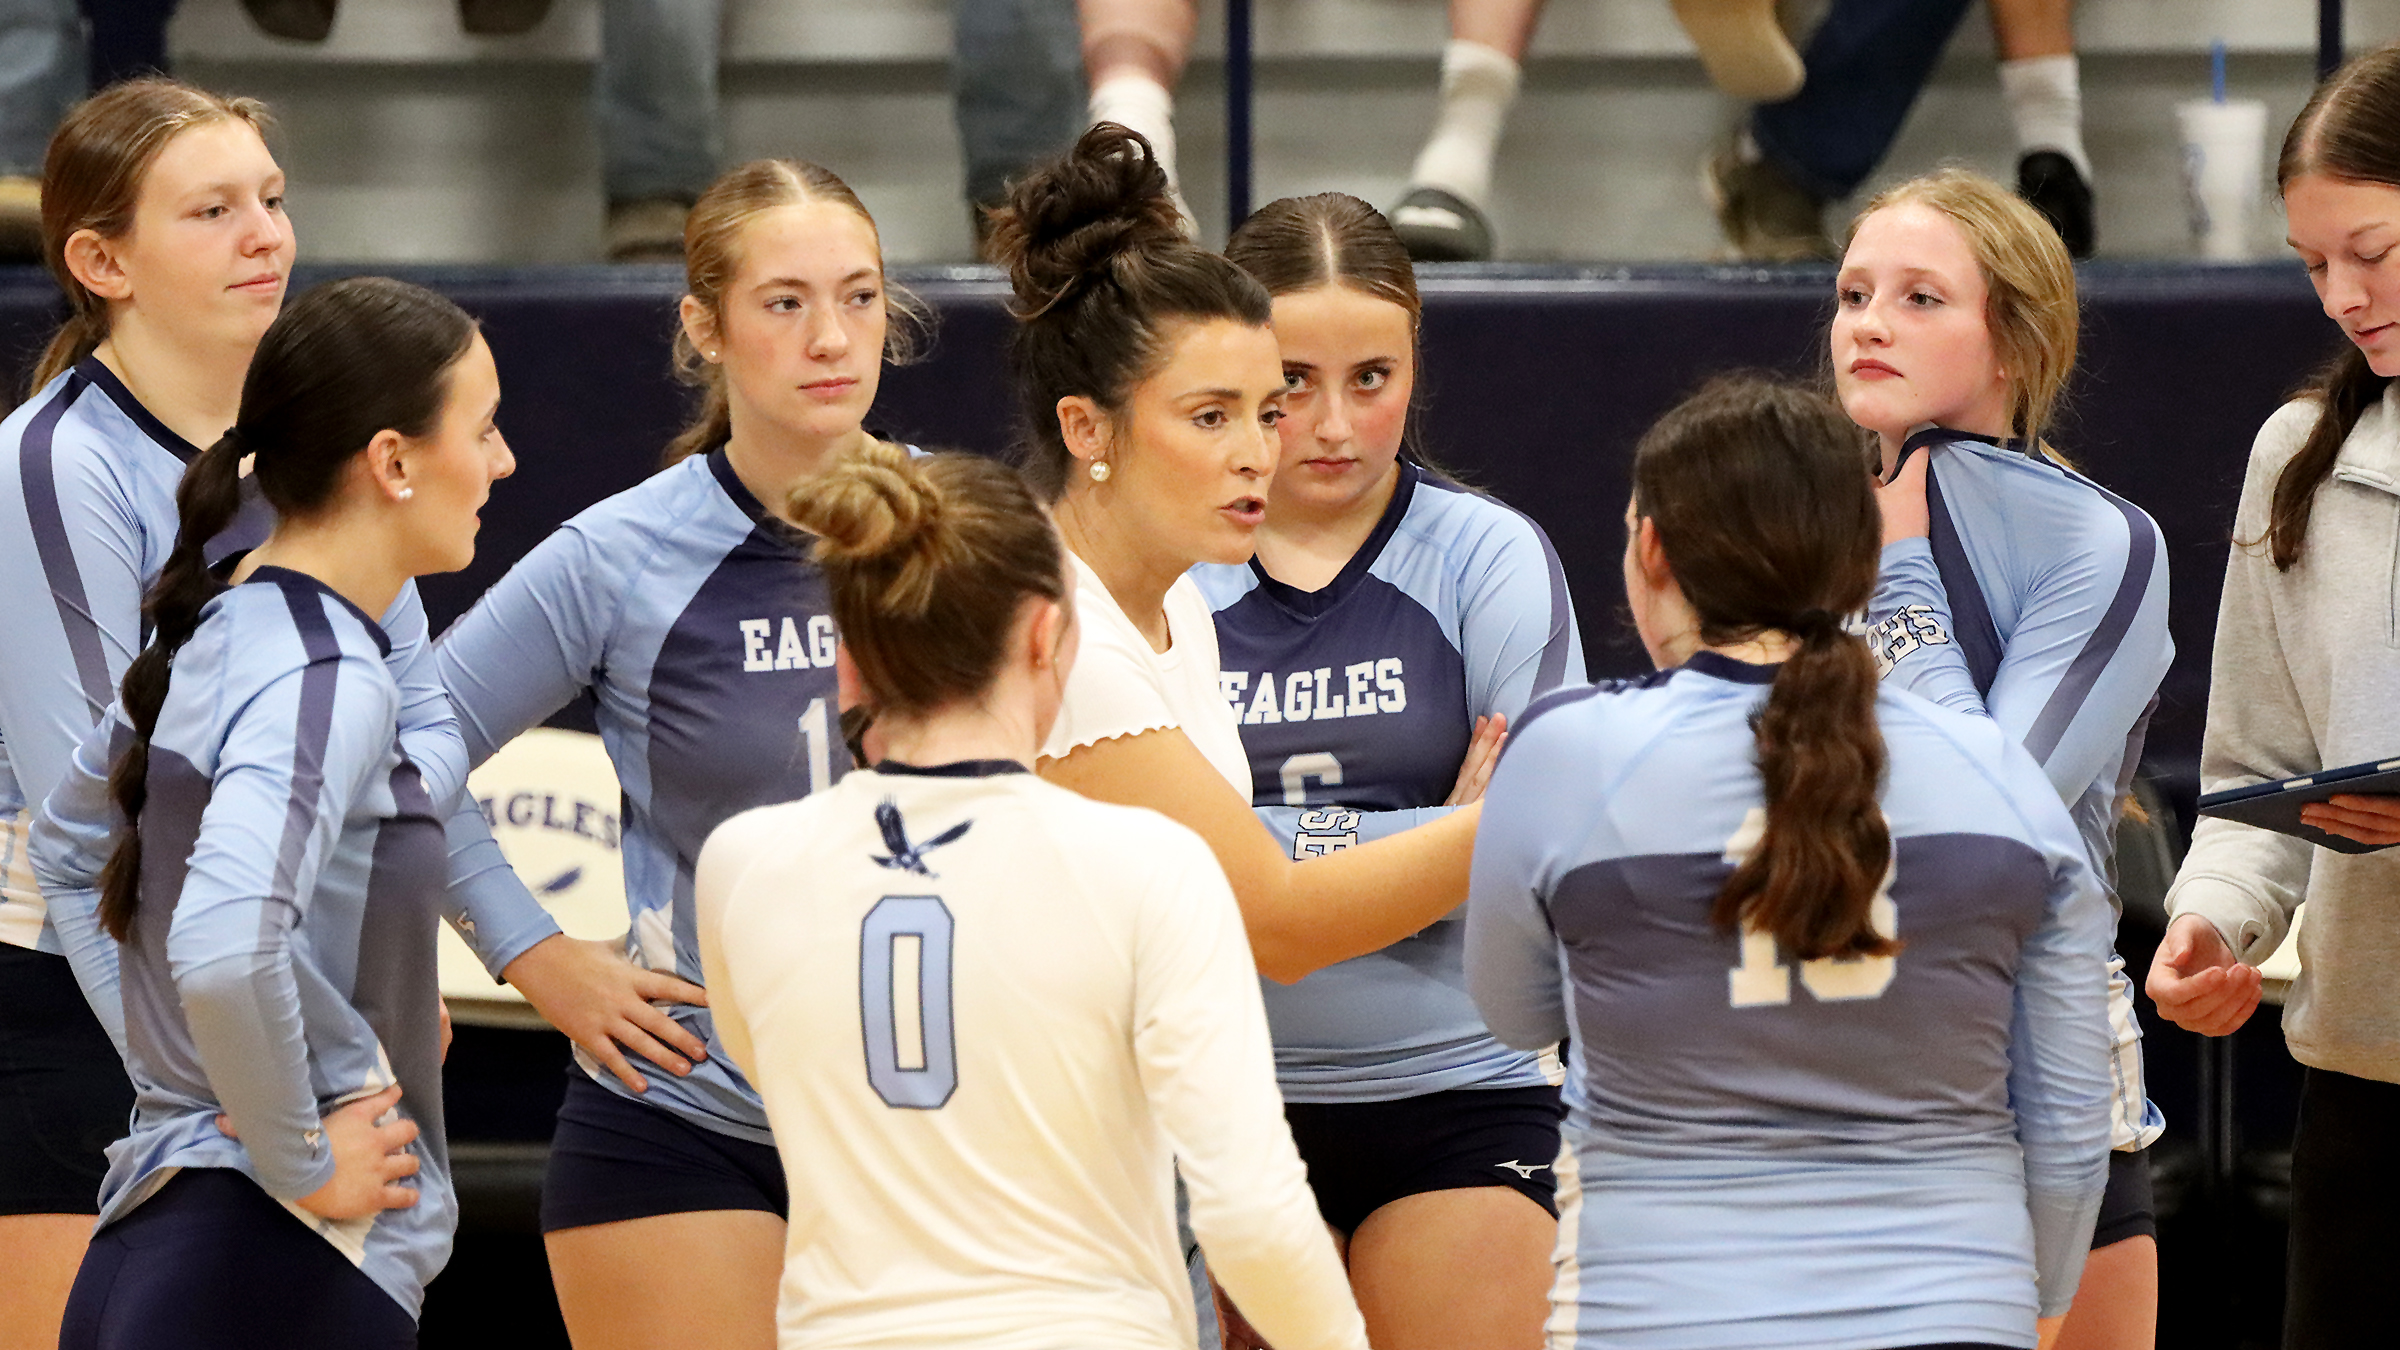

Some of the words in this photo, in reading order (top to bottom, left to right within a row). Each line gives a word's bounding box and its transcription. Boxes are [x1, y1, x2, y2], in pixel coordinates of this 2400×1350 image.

[739, 614, 840, 672] EAG
[1220, 657, 1407, 725] EAGLES
[859, 895, 959, 1109] 0
